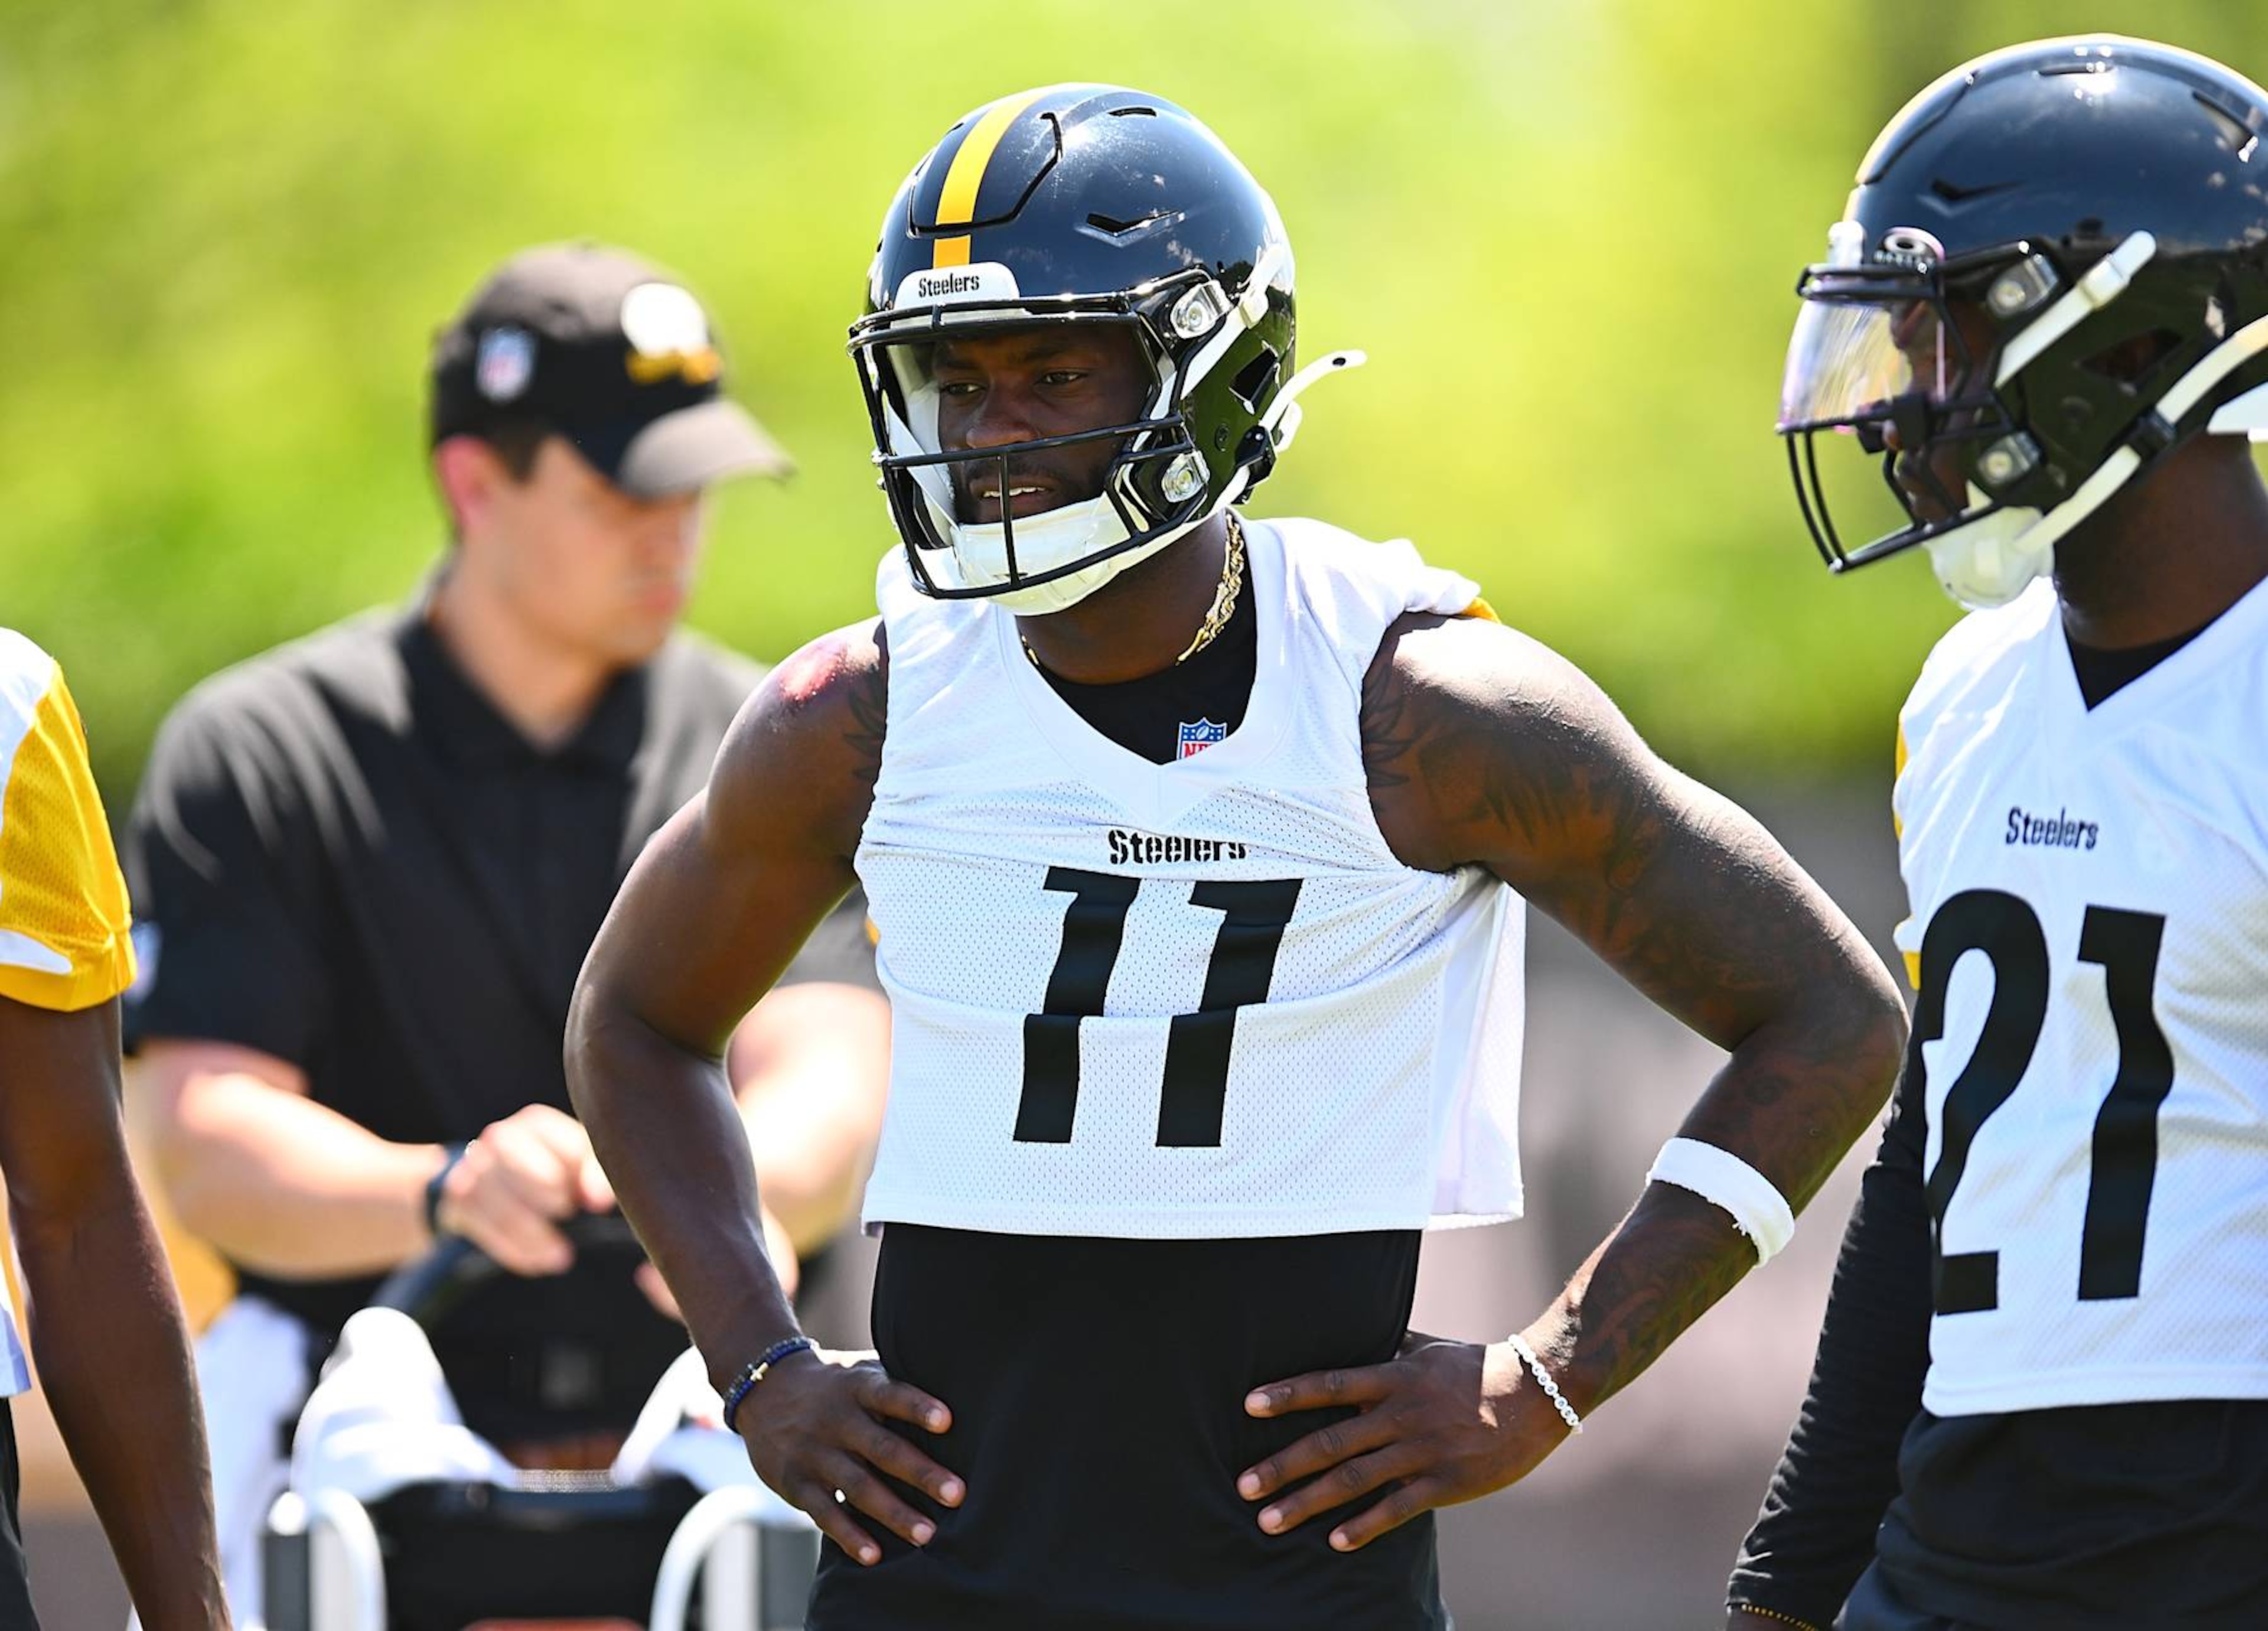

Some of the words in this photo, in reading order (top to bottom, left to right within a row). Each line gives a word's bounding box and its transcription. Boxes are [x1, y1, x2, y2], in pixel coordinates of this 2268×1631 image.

[918, 272, 980, 298] Steelers
[1108, 829, 1246, 864] Steelers
[2006, 806, 2099, 850] Steelers
[1013, 865, 1304, 1147] 11
[1921, 888, 2174, 1316] 21
